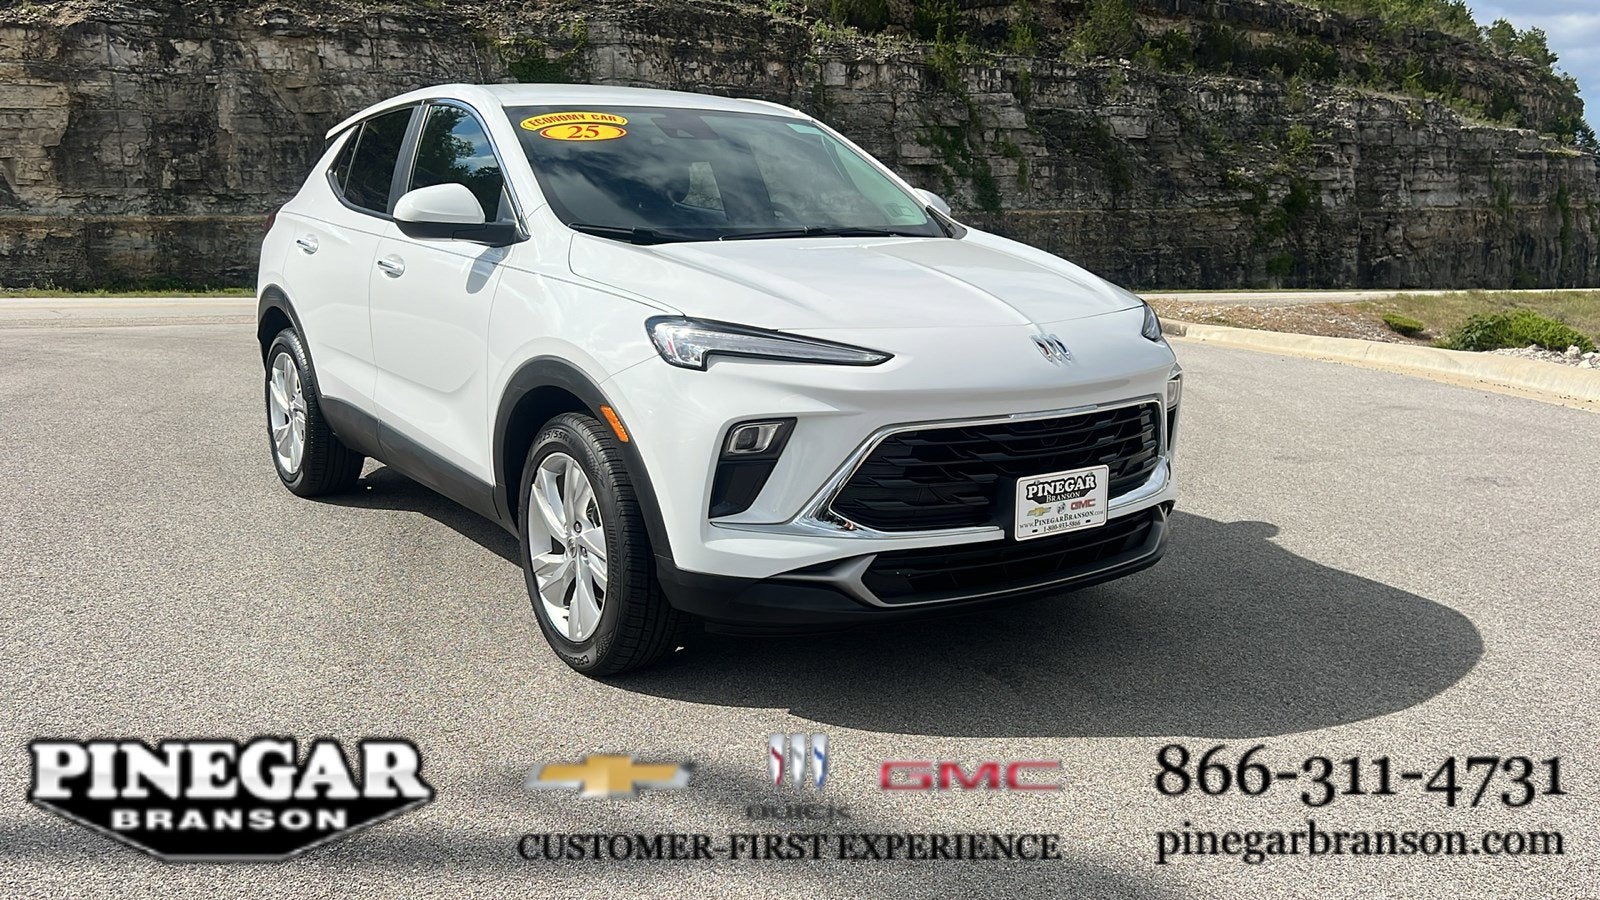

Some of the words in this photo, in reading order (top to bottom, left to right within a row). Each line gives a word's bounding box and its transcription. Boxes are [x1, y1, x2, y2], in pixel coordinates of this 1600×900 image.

[528, 114, 586, 127] ECONOMY
[591, 114, 617, 122] CAR
[567, 125, 600, 139] 25
[1027, 476, 1095, 498] PINEGAR
[1046, 491, 1081, 503] BRANSON
[1070, 498, 1096, 511] GMC
